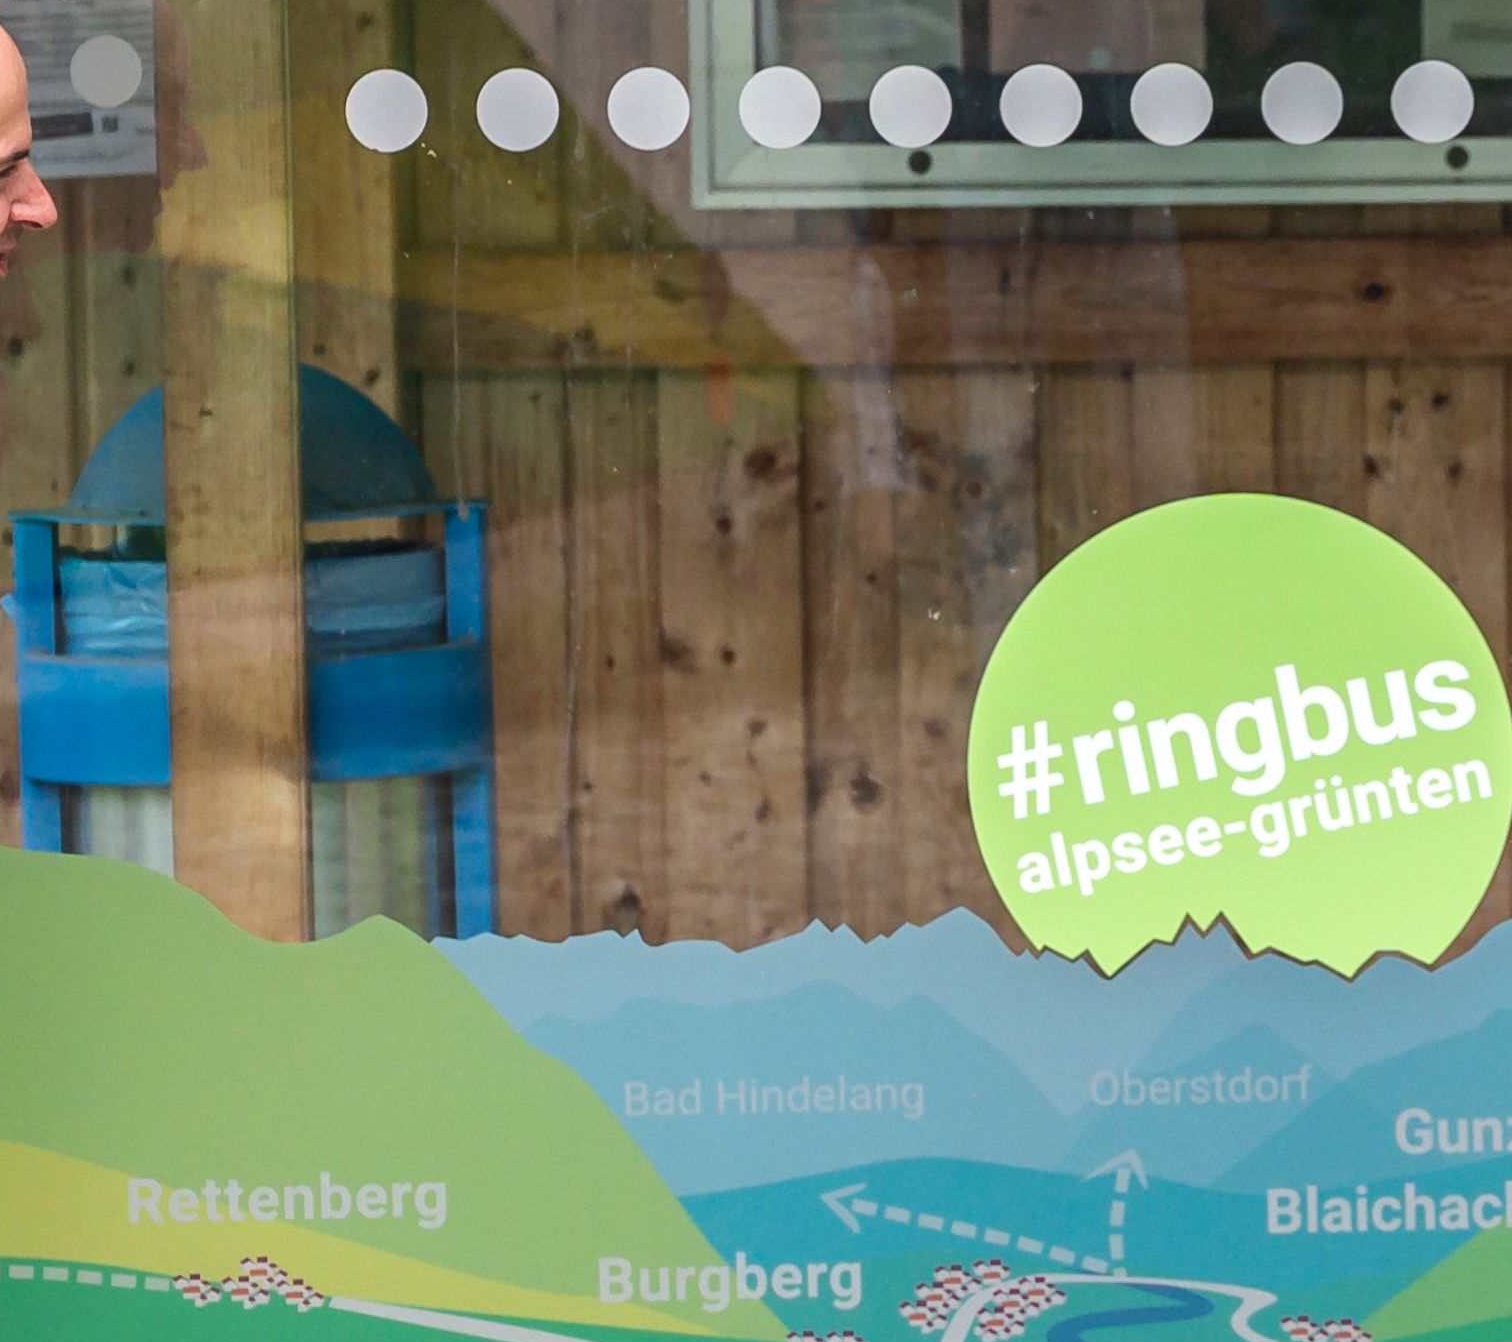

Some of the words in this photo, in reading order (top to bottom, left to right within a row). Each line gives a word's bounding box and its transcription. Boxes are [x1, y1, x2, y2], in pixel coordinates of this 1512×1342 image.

[997, 658, 1478, 820] #ringbus
[1016, 758, 1493, 897] alpsee-grünten
[623, 1078, 701, 1118] Bad
[716, 1075, 926, 1119] Hindelang
[1090, 1062, 1312, 1106] Oberstdorf
[126, 1171, 449, 1230] Rettenberg
[598, 1255, 863, 1311] Burgberg
